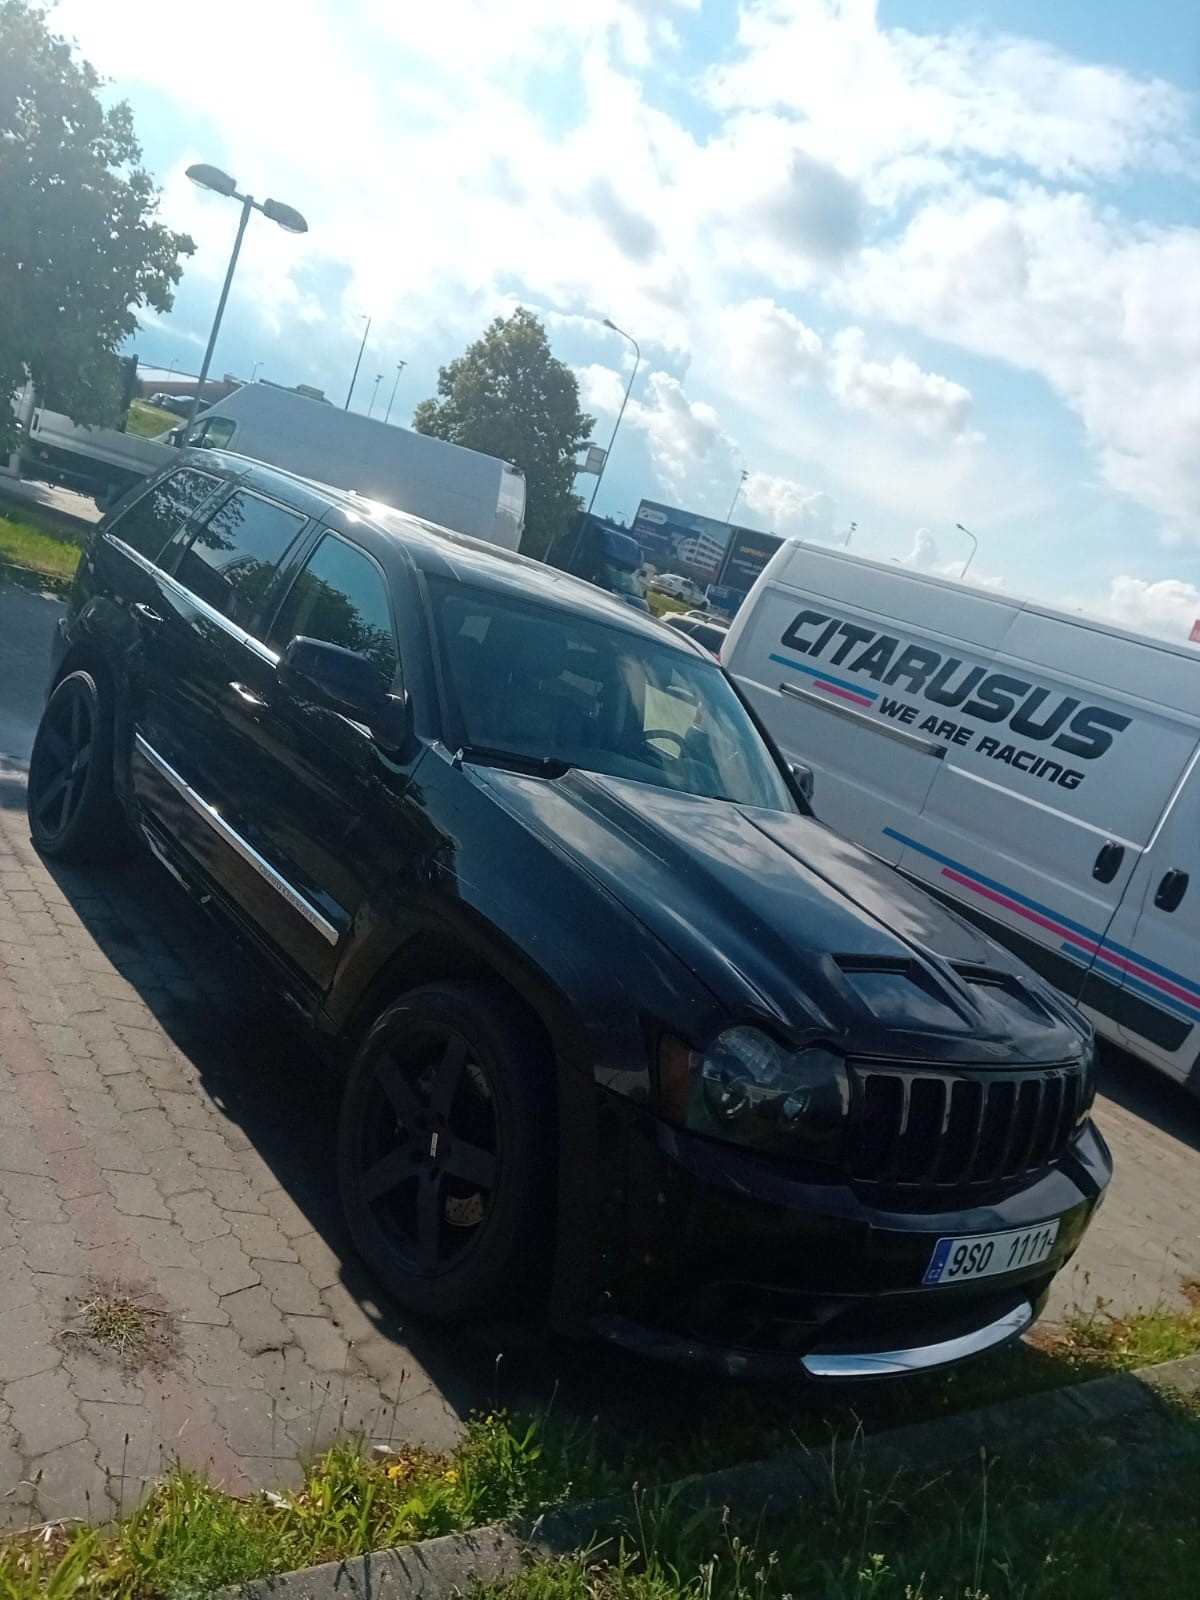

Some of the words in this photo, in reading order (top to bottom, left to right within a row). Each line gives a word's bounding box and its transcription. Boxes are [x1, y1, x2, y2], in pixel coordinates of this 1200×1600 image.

[780, 609, 1133, 760] CITARUSUS
[878, 696, 920, 725] WE
[919, 715, 975, 746] ARE
[975, 736, 1086, 790] RACING
[1007, 1228, 1051, 1267] 1111
